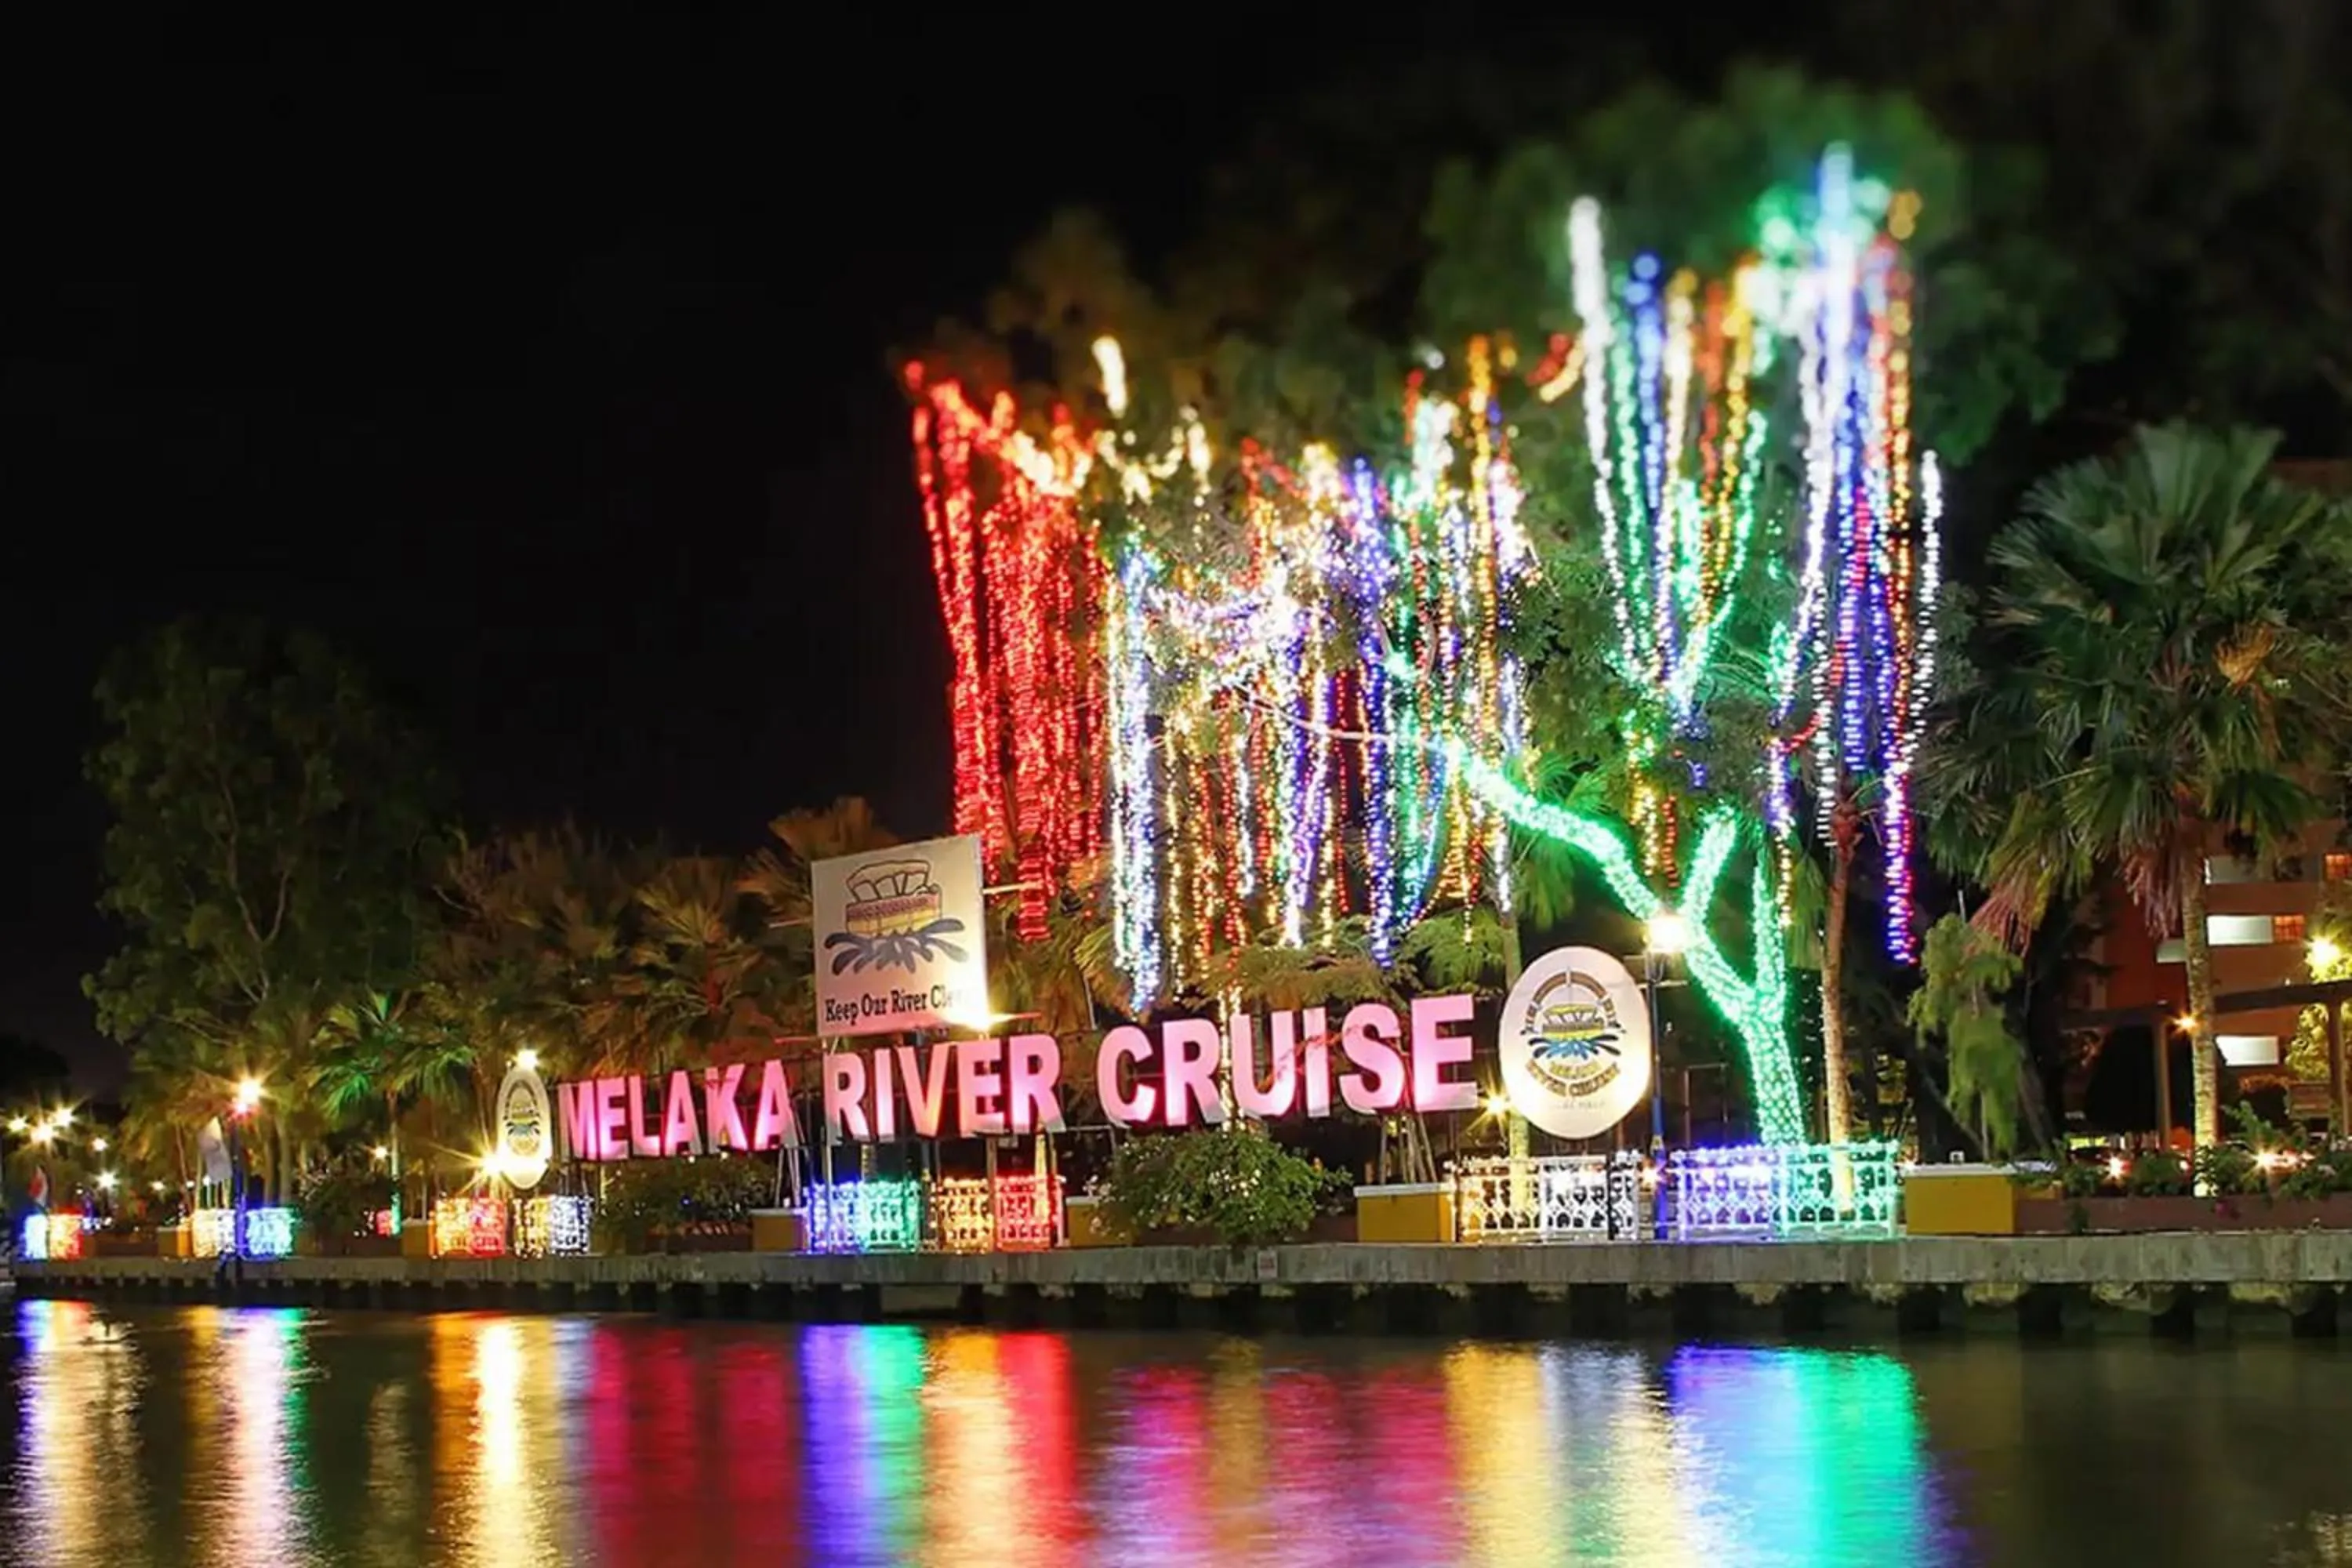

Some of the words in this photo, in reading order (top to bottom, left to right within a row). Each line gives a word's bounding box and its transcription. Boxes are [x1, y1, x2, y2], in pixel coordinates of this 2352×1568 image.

[825, 997, 859, 1025] Keep
[862, 993, 887, 1017] Our
[891, 989, 927, 1014] River
[557, 1059, 798, 1162] MELAKA
[824, 1034, 1066, 1146] RIVER
[1098, 994, 1478, 1128] CRUISE
